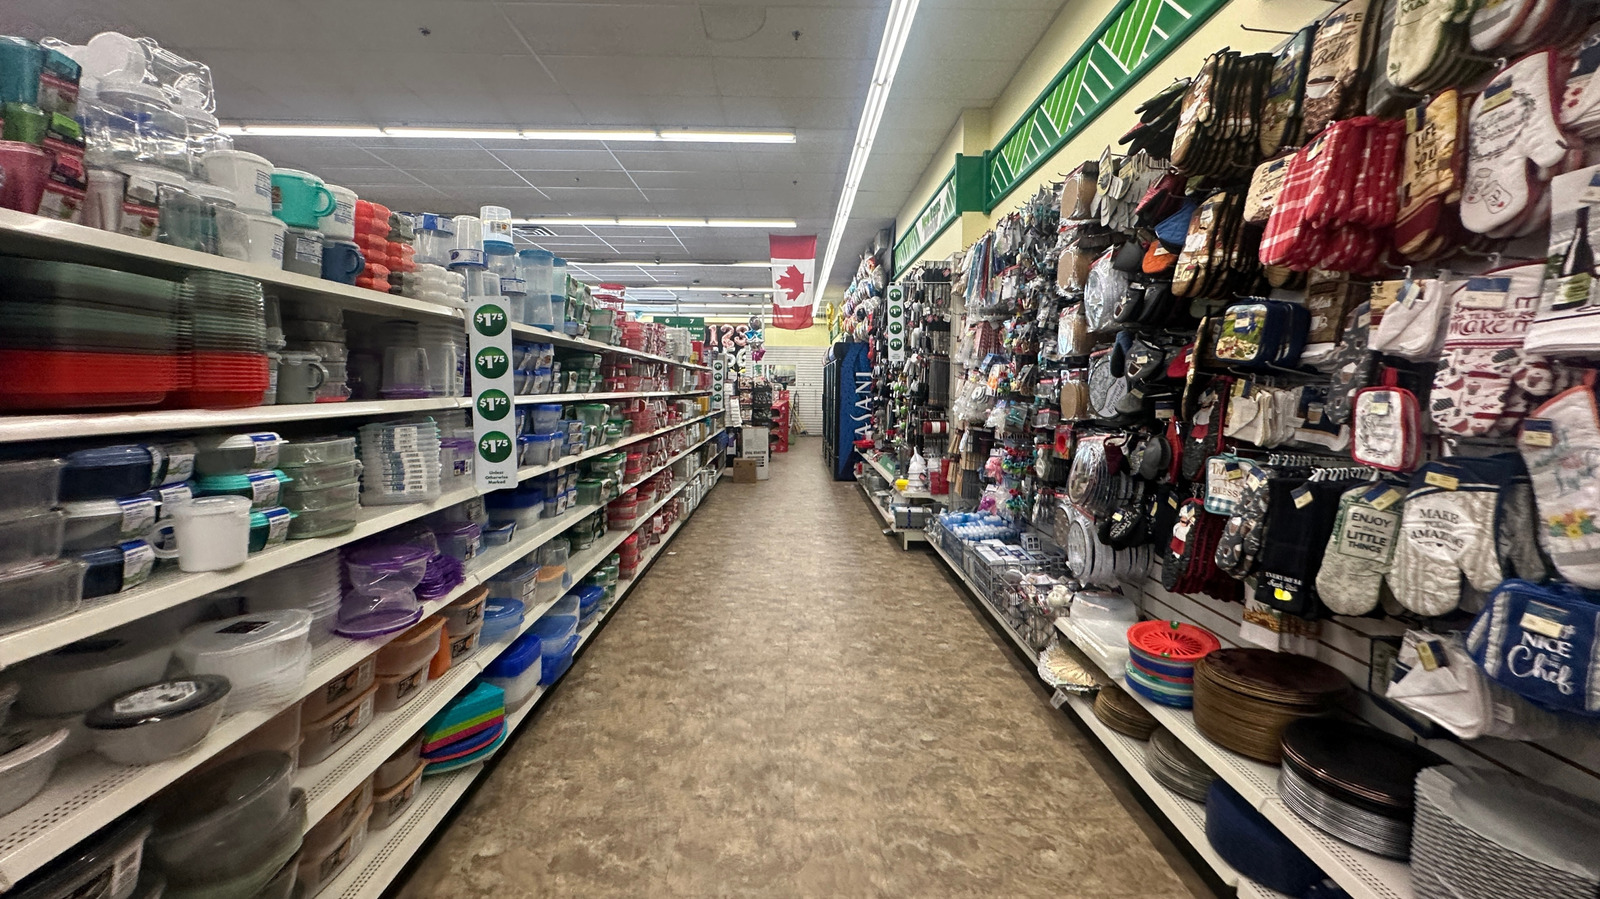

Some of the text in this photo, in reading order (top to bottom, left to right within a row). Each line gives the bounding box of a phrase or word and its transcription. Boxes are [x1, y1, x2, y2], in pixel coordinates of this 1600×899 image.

[849, 372, 873, 436] ASANI
[1212, 486, 1239, 498] BLESS
[1352, 512, 1391, 528] ENJOY
[1419, 508, 1459, 524] MAKE
[1346, 530, 1388, 546] LITTLE
[1347, 540, 1383, 554] THINGS
[1521, 630, 1575, 659] NICE
[1507, 644, 1576, 696] Chef
